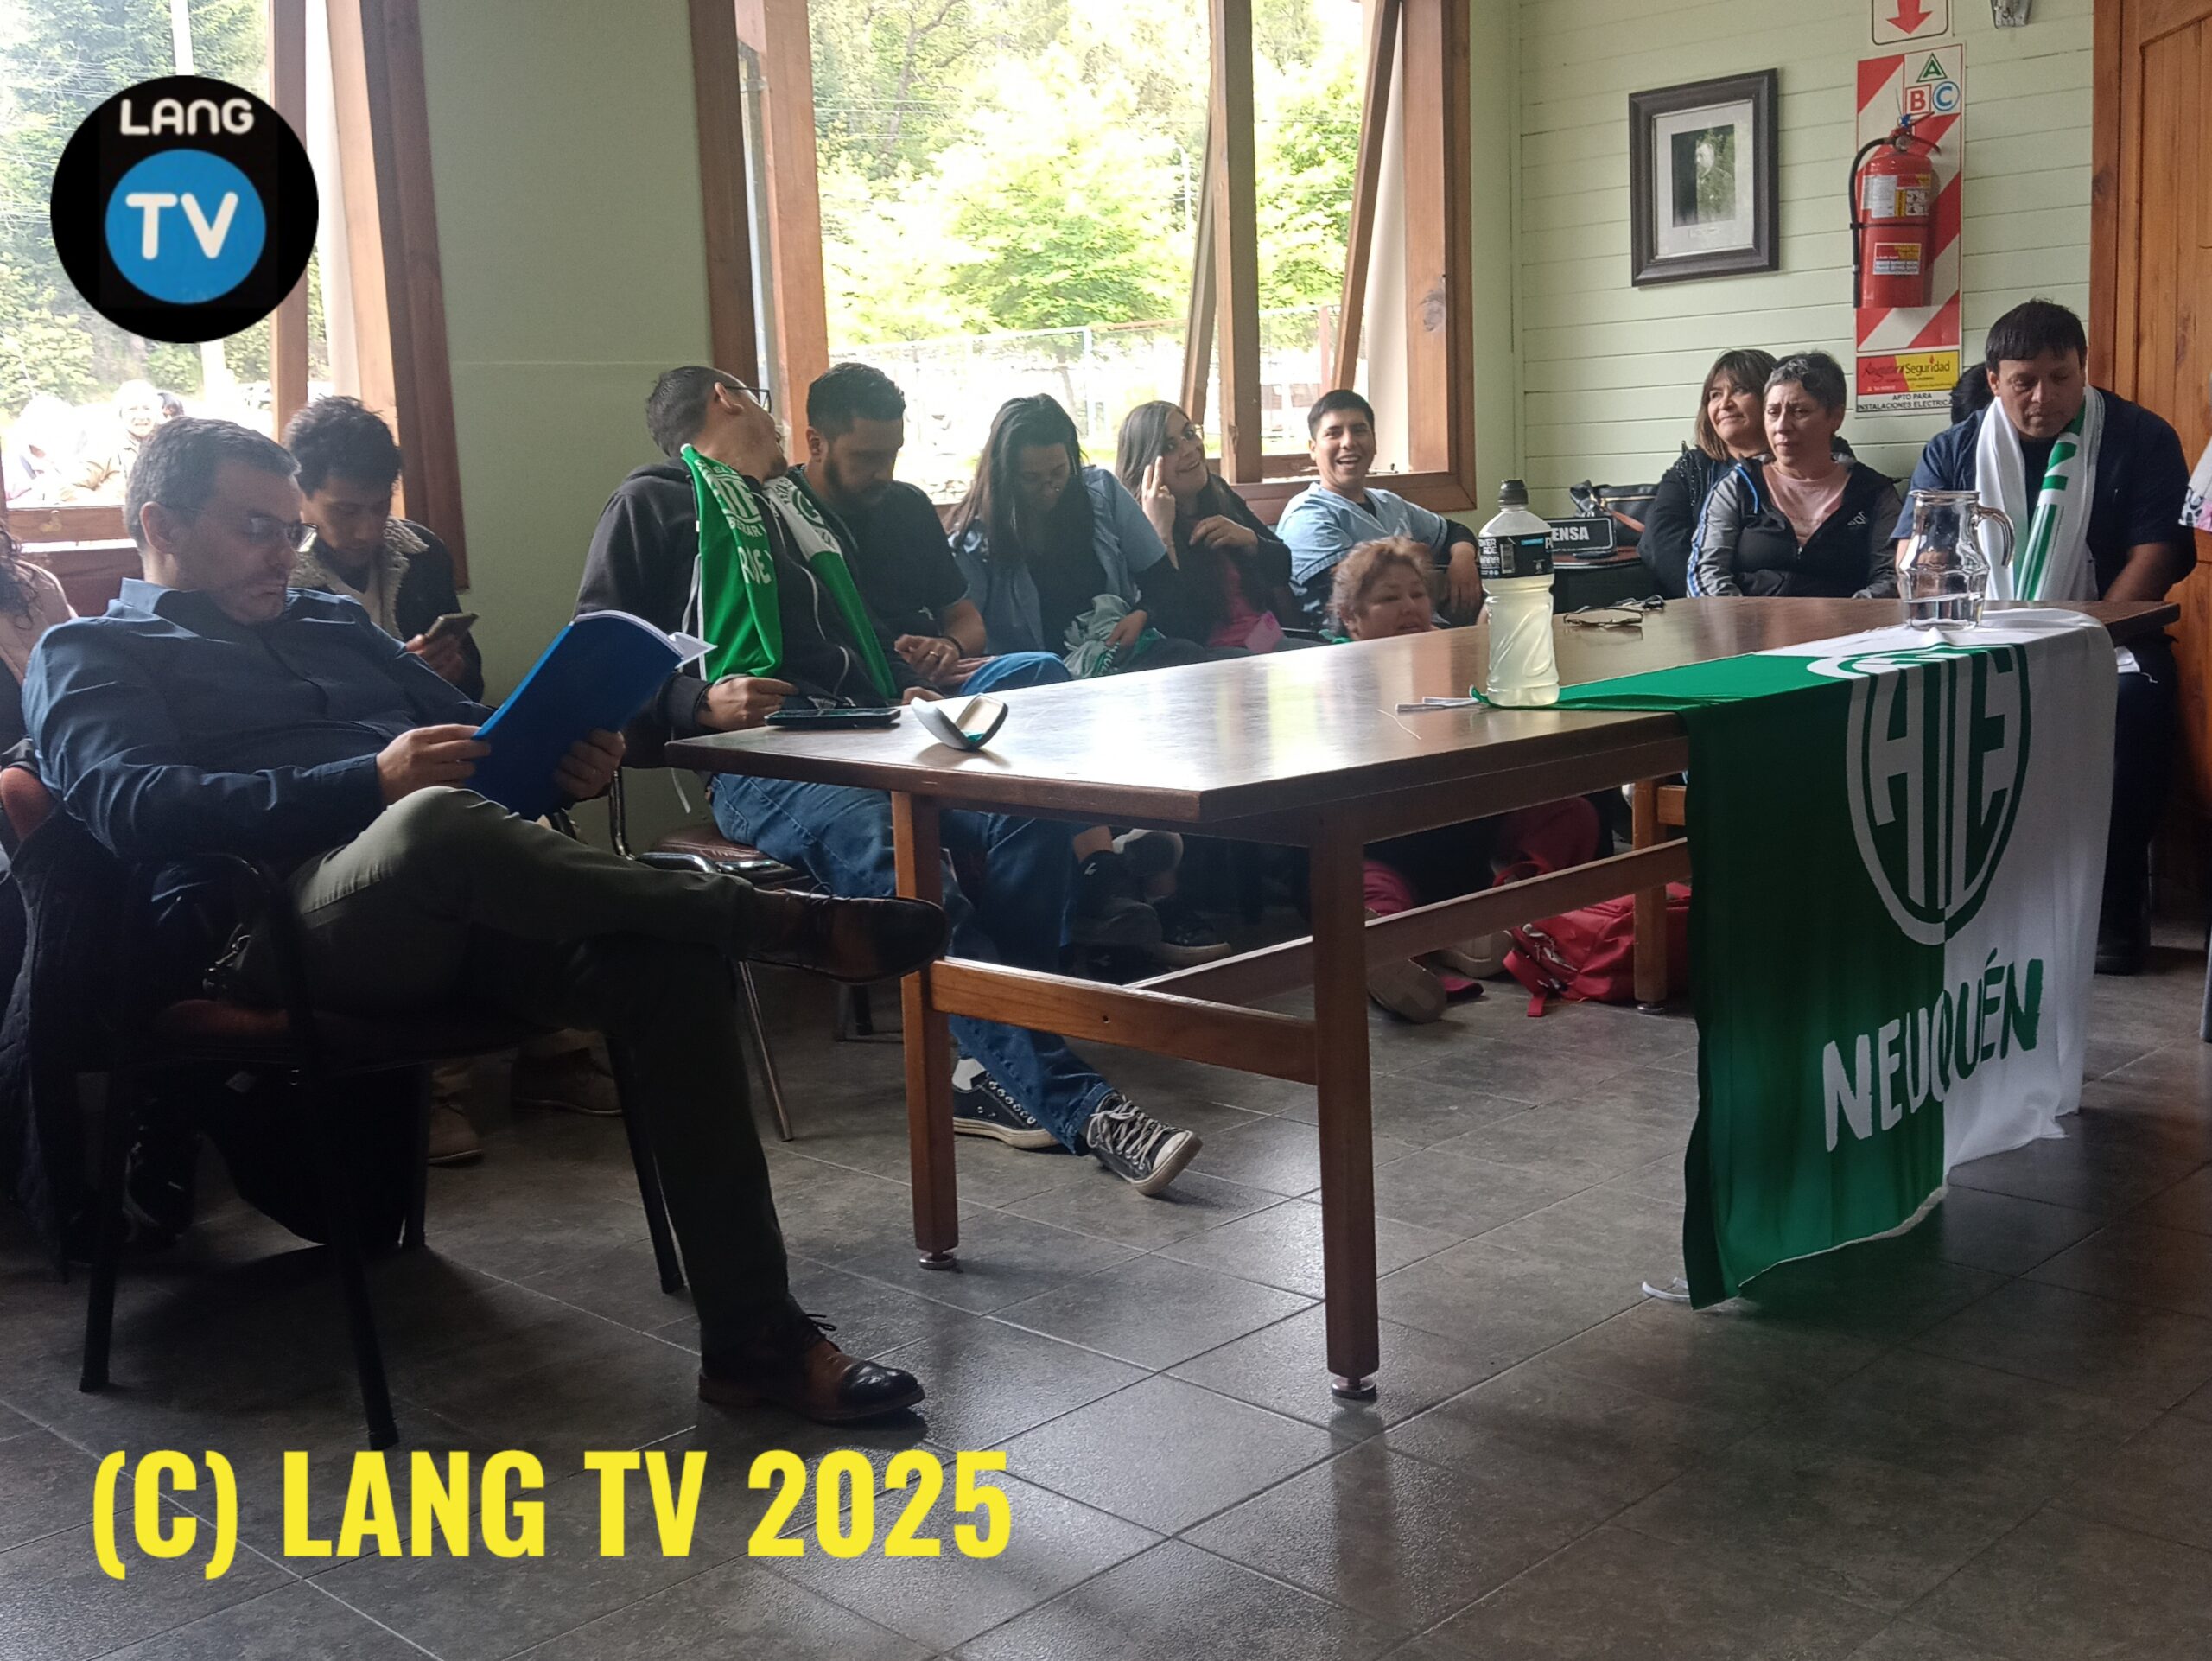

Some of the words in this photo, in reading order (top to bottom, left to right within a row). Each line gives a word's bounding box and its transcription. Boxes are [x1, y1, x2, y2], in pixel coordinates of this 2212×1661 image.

[1923, 60, 1942, 78] A
[1910, 89, 1926, 111] B
[1936, 86, 1953, 108] C
[1905, 361, 1950, 376] Seguridad
[1914, 399, 1953, 408] ELECTRICA
[1552, 526, 1590, 542] ENSA
[1822, 947, 2044, 1152] NEUQUÉN
